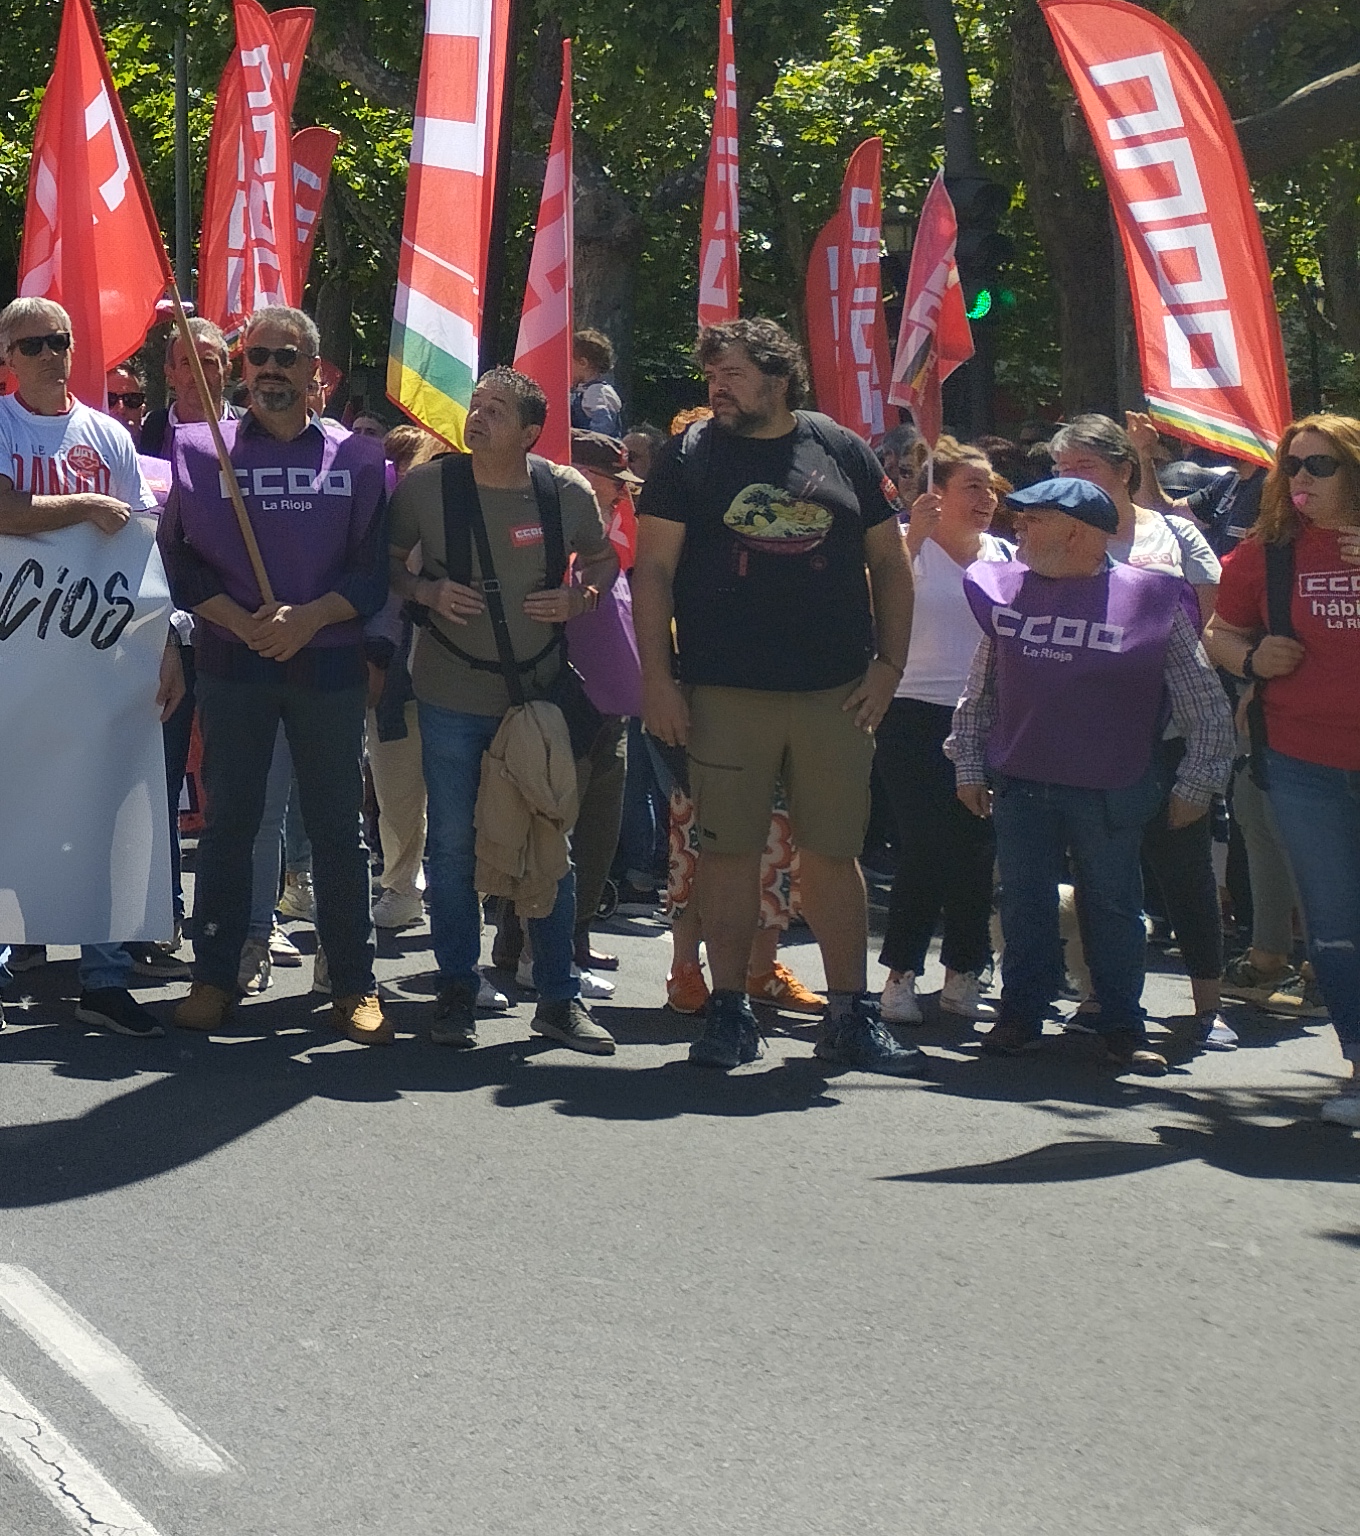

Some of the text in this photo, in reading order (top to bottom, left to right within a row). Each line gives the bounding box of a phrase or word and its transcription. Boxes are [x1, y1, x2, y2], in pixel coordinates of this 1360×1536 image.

[219, 467, 352, 499] CCOO
[262, 500, 313, 512] La Rioja
[991, 604, 1125, 653] CCOO
[1326, 618, 1344, 629] La
[1022, 645, 1073, 662] La Rioja
